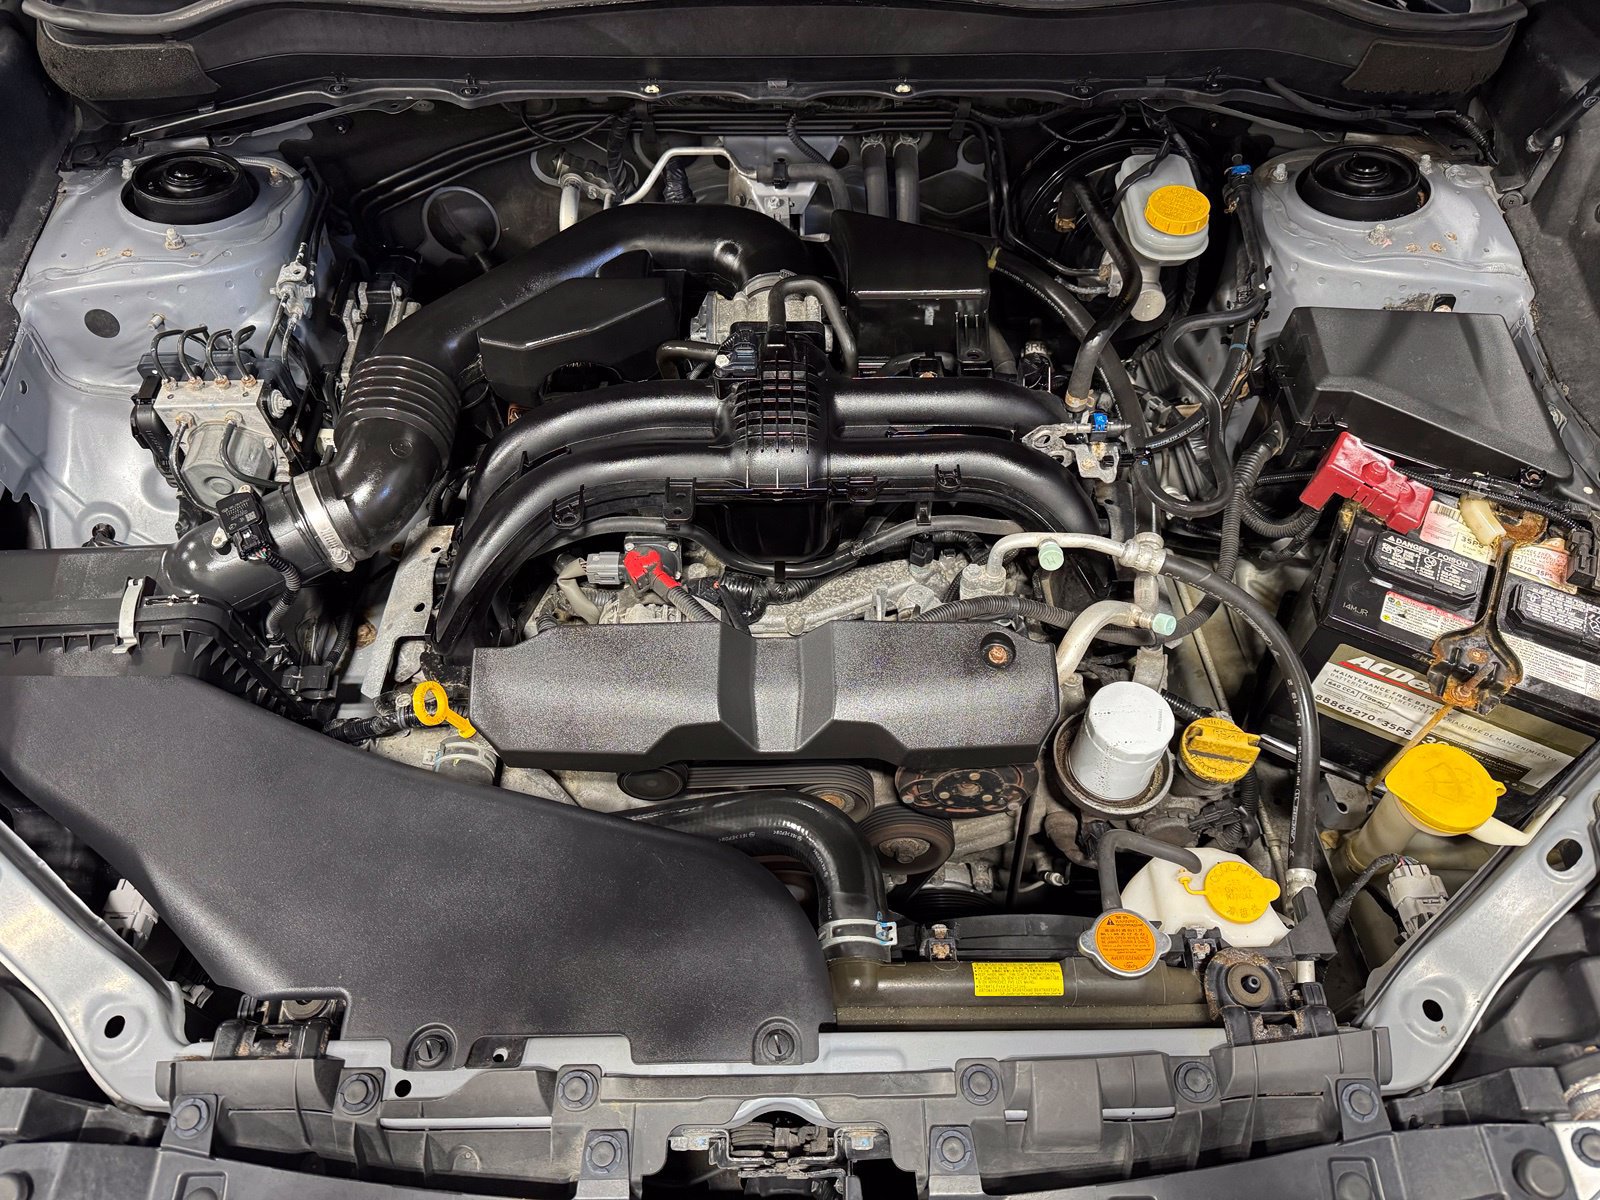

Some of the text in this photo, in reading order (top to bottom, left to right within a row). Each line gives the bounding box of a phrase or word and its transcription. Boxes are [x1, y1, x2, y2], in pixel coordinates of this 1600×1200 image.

[1396, 537, 1430, 555] DANGER
[1437, 552, 1469, 568] POISON
[1342, 687, 1355, 695] CCA
[1346, 656, 1431, 692] ACDe
[1333, 669, 1390, 694] MAINTENANCE
[1392, 691, 1412, 702] FREE
[1416, 700, 1453, 716] BATTEY
[1315, 693, 1375, 722] 88865270
[1382, 720, 1413, 737] 35PS
